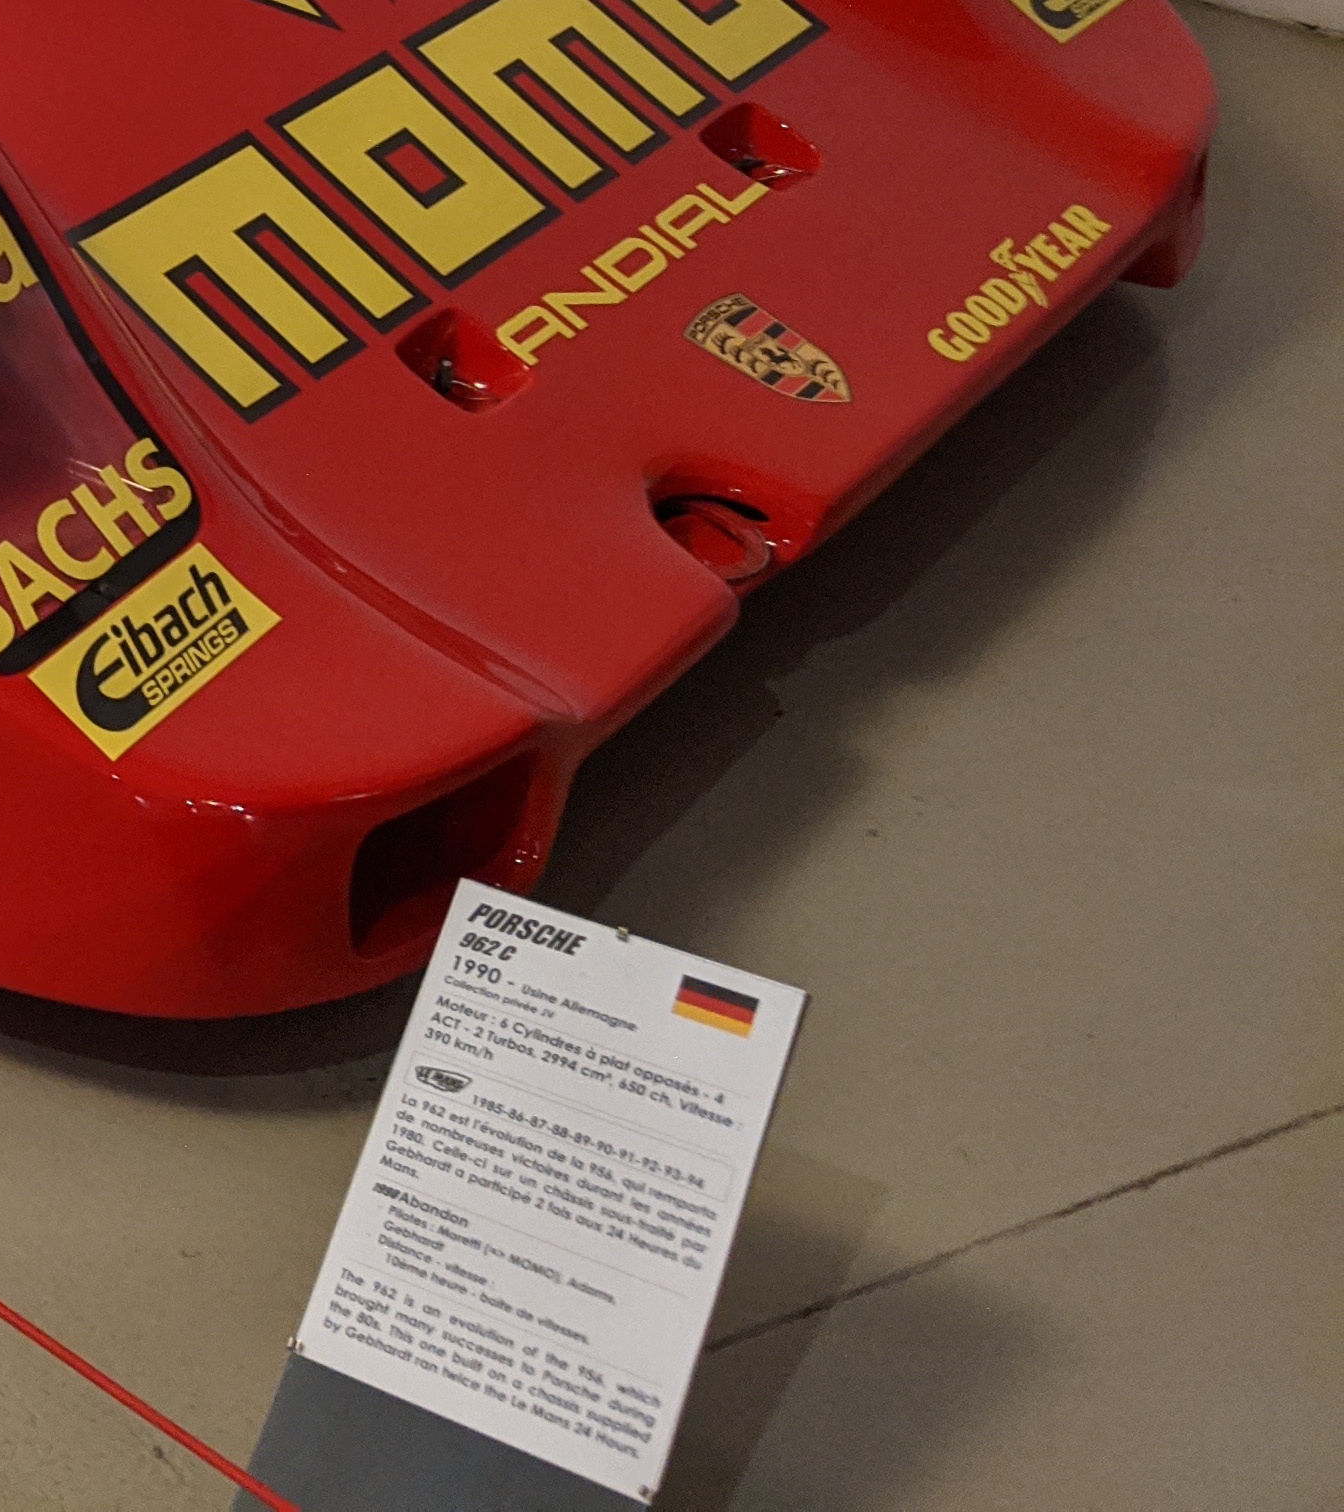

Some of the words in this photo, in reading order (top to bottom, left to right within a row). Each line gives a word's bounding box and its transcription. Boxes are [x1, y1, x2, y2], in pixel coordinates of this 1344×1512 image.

[496, 181, 770, 367] ANDIAL
[927, 204, 1112, 362] GOODYEAR
[76, 564, 232, 732] Eibach
[141, 618, 240, 707] SPRINGS
[458, 931, 501, 956] 962
[468, 903, 585, 955] PORSCHE
[452, 954, 502, 984] 1990
[423, 1026, 452, 1045] 390
[452, 1037, 494, 1060] km/h
[429, 1011, 462, 1030] ACT
[540, 1049, 578, 1071] 2994
[435, 995, 488, 1021] Moteur
[511, 1021, 581, 1055] Cylindres
[397, 1191, 469, 1227] Abandon
